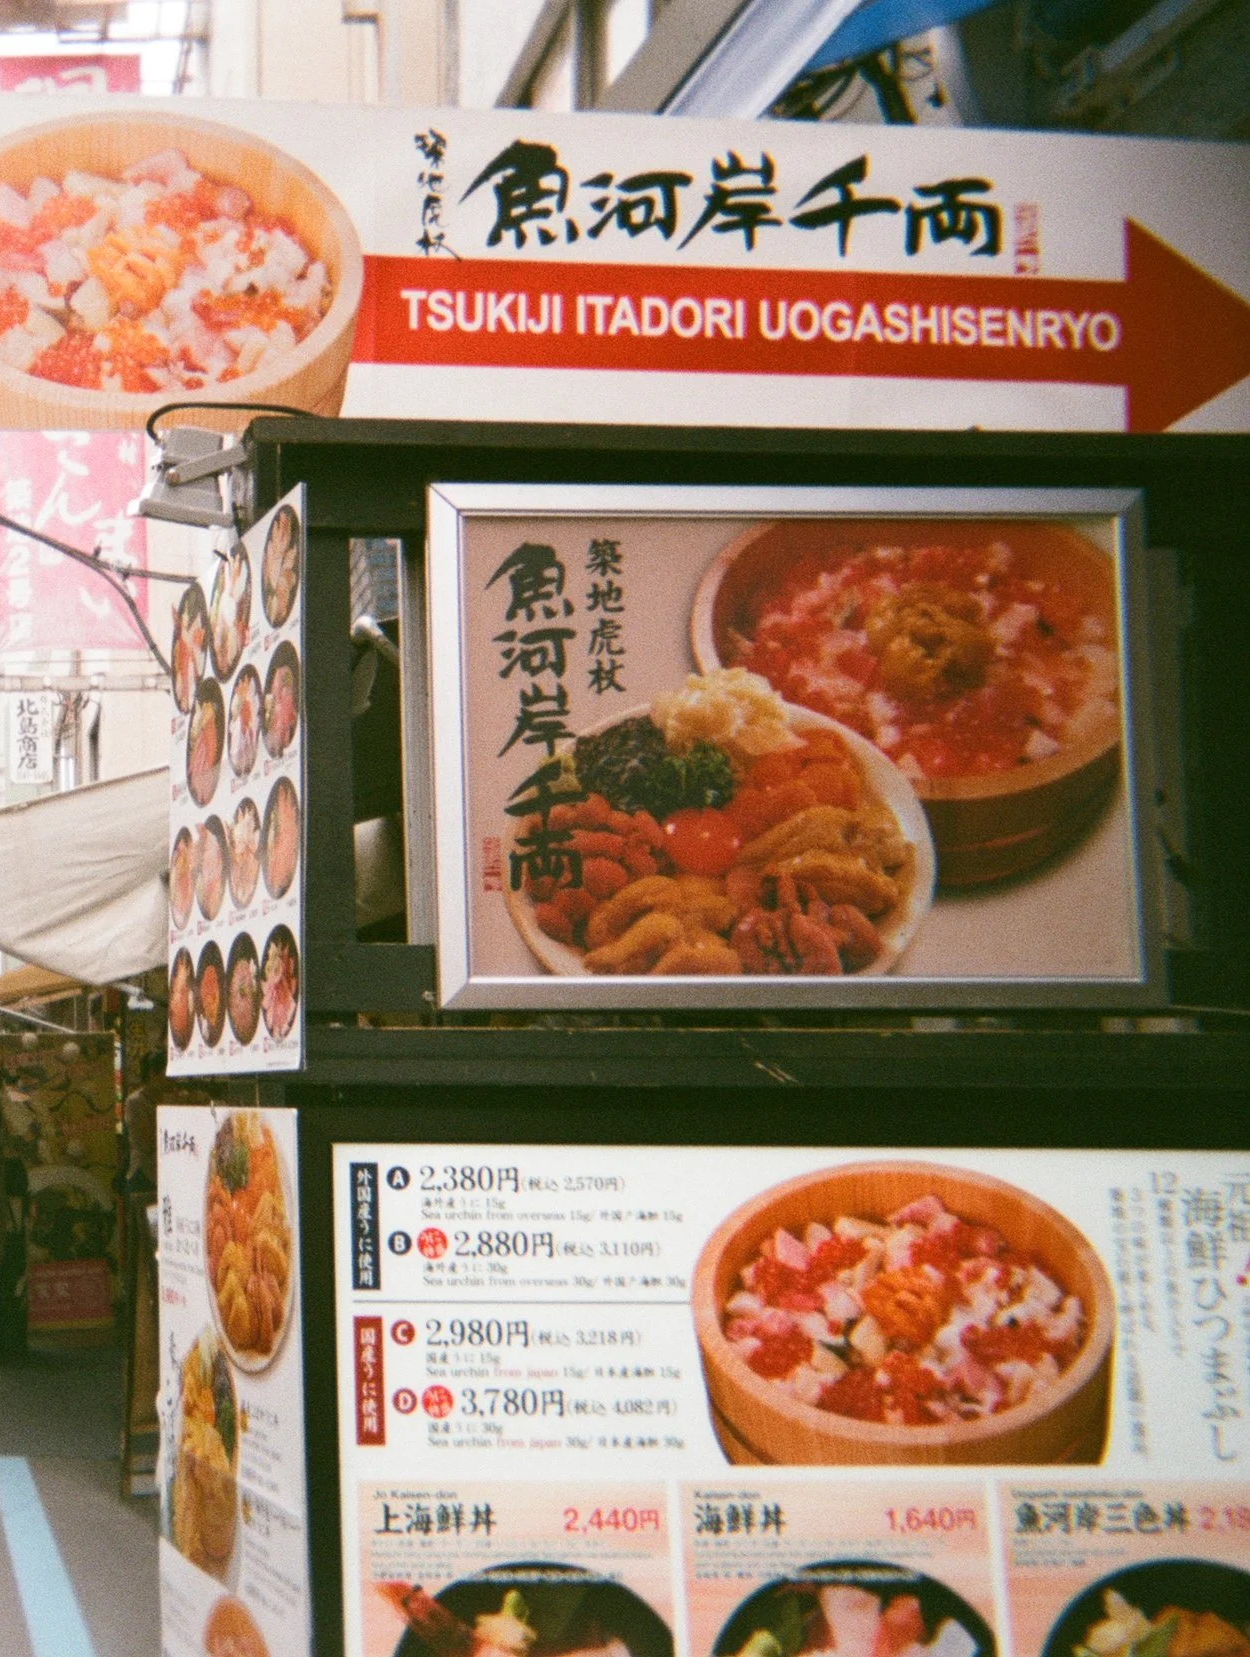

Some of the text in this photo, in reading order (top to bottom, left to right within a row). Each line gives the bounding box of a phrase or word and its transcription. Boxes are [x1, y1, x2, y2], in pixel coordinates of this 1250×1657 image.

[458, 138, 1004, 258] 魚河岸千両
[400, 289, 1122, 352] TSUKIJI ITADORI UOGASHISENRYO
[585, 538, 626, 695] 築地虎杖
[15, 698, 40, 771] 北島商店
[483, 541, 589, 892] 魚河岸千両
[419, 1165, 520, 1193] 2,380円
[454, 1231, 556, 1259] 2,880円
[425, 1318, 530, 1347] 2,980円
[460, 1388, 566, 1417] 3,780円
[373, 1501, 661, 1537] 上海鮮丼 2,440円
[693, 1501, 979, 1537] 海鮮丼 1,640円
[1014, 1500, 1191, 1536] 魚河岸三色丼
